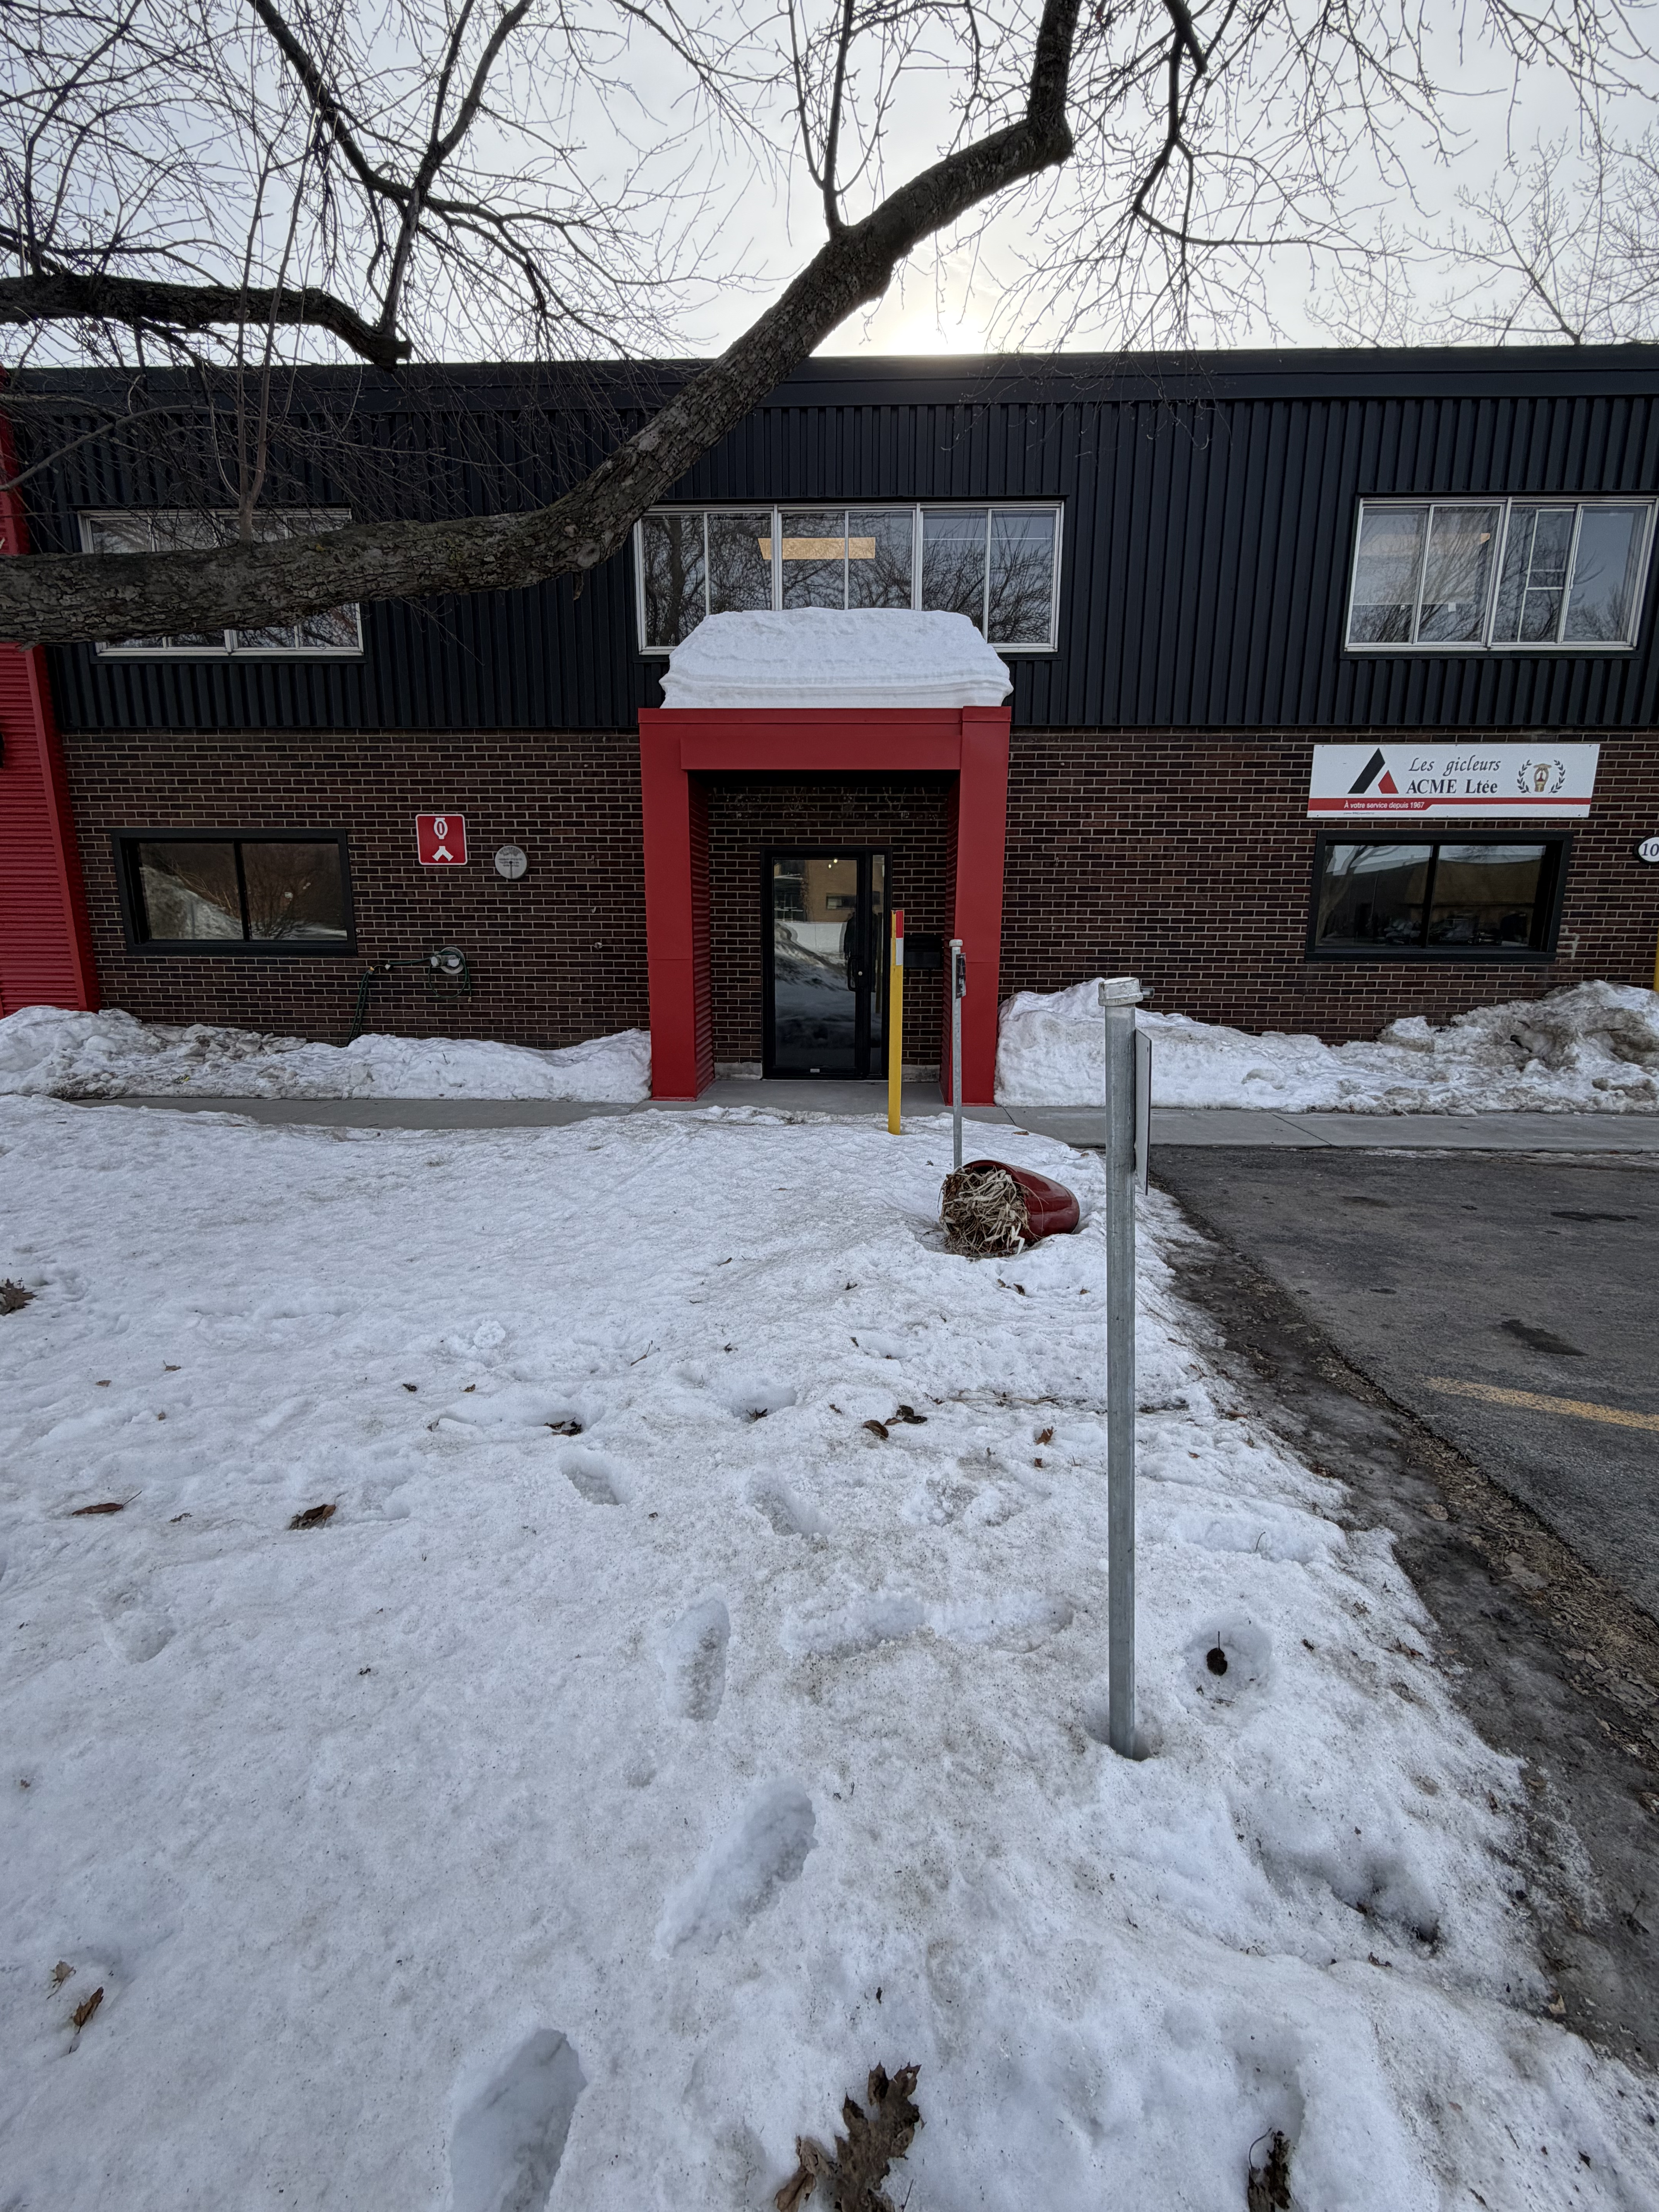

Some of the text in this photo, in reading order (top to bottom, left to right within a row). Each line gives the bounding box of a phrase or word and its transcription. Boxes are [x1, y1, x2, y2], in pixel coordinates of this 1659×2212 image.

[1408, 755, 1501, 776] Les gicleurs
[1405, 779, 1498, 794] ACME Ltée
[1344, 800, 1349, 809] À
[1641, 843, 1659, 857] 10
